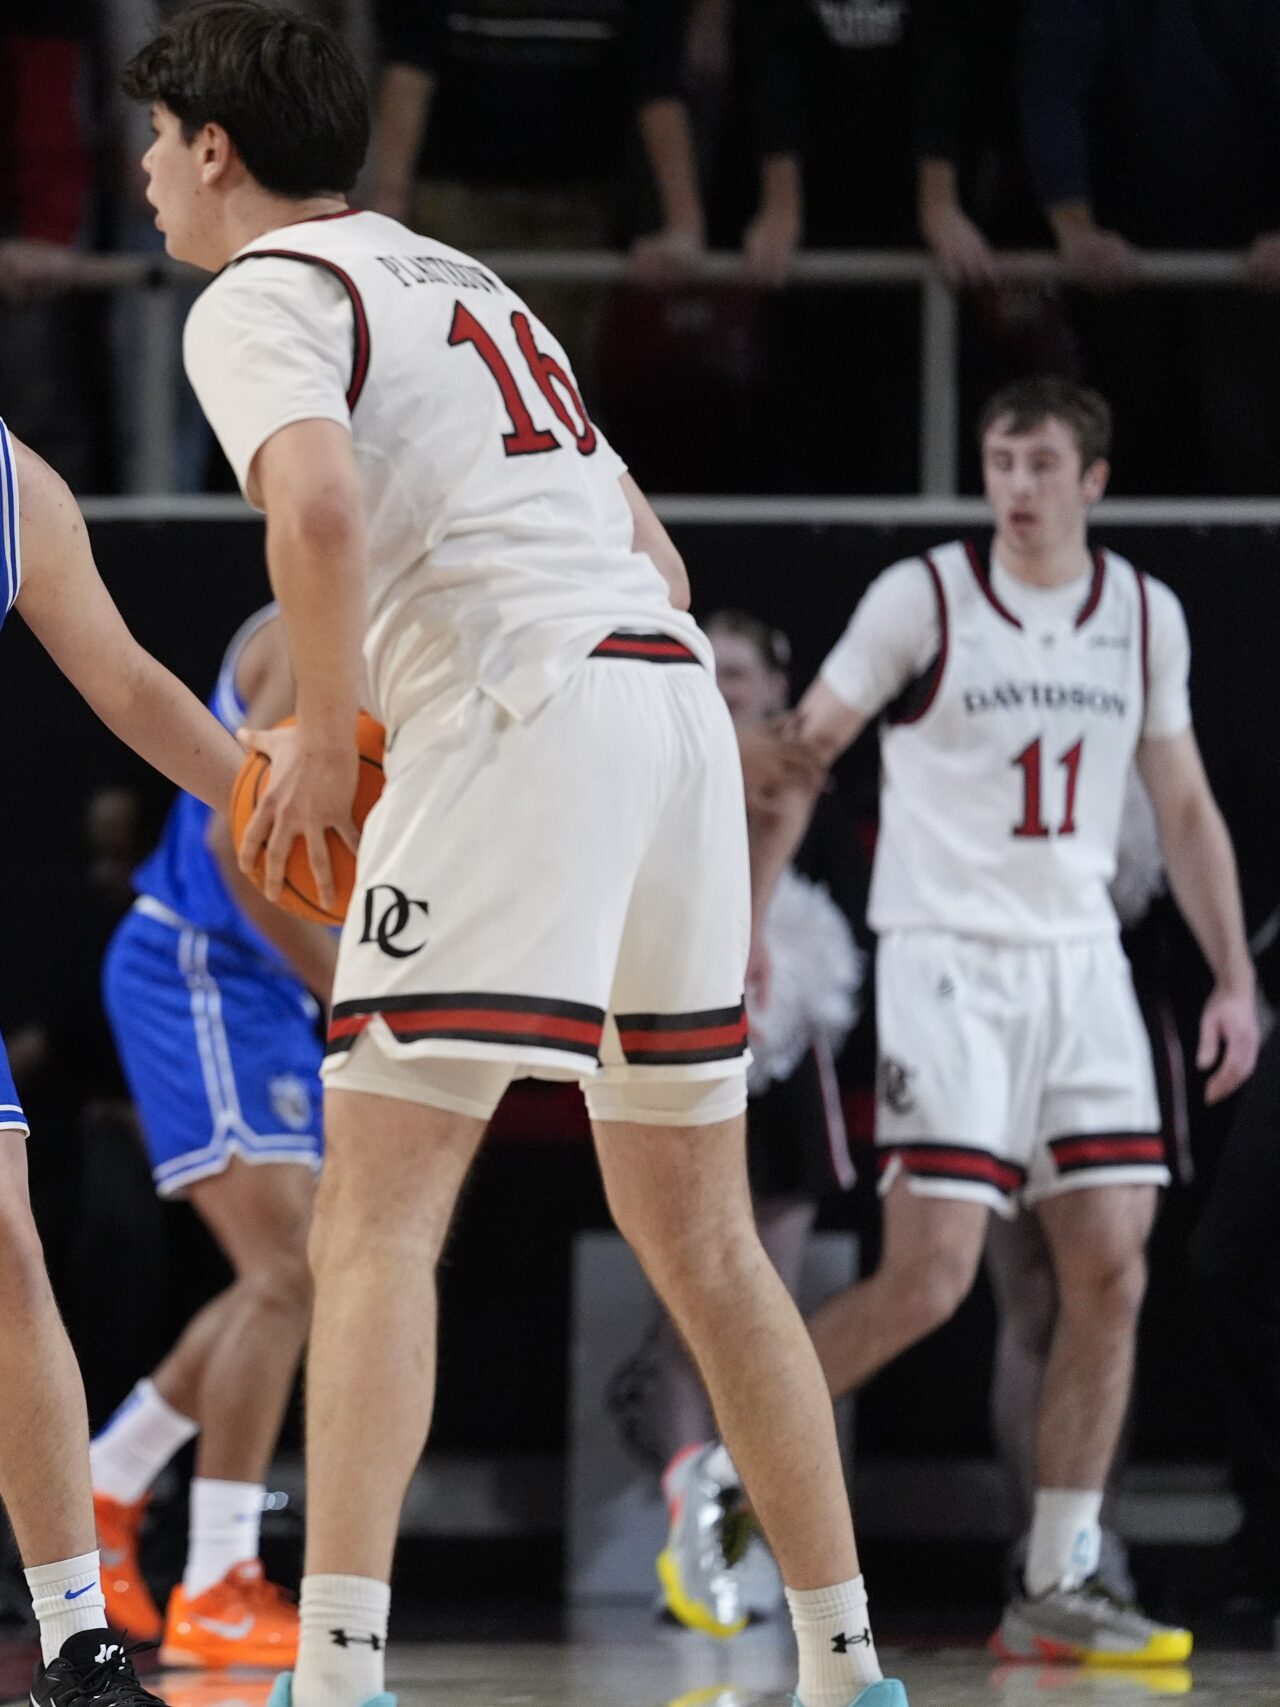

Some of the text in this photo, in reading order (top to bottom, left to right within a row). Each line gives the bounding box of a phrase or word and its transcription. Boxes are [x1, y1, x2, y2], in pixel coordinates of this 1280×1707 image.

[447, 299, 597, 458] 16
[963, 683, 1127, 719] DAVIDSON
[1009, 735, 1084, 838] 11
[359, 884, 429, 959] DC
